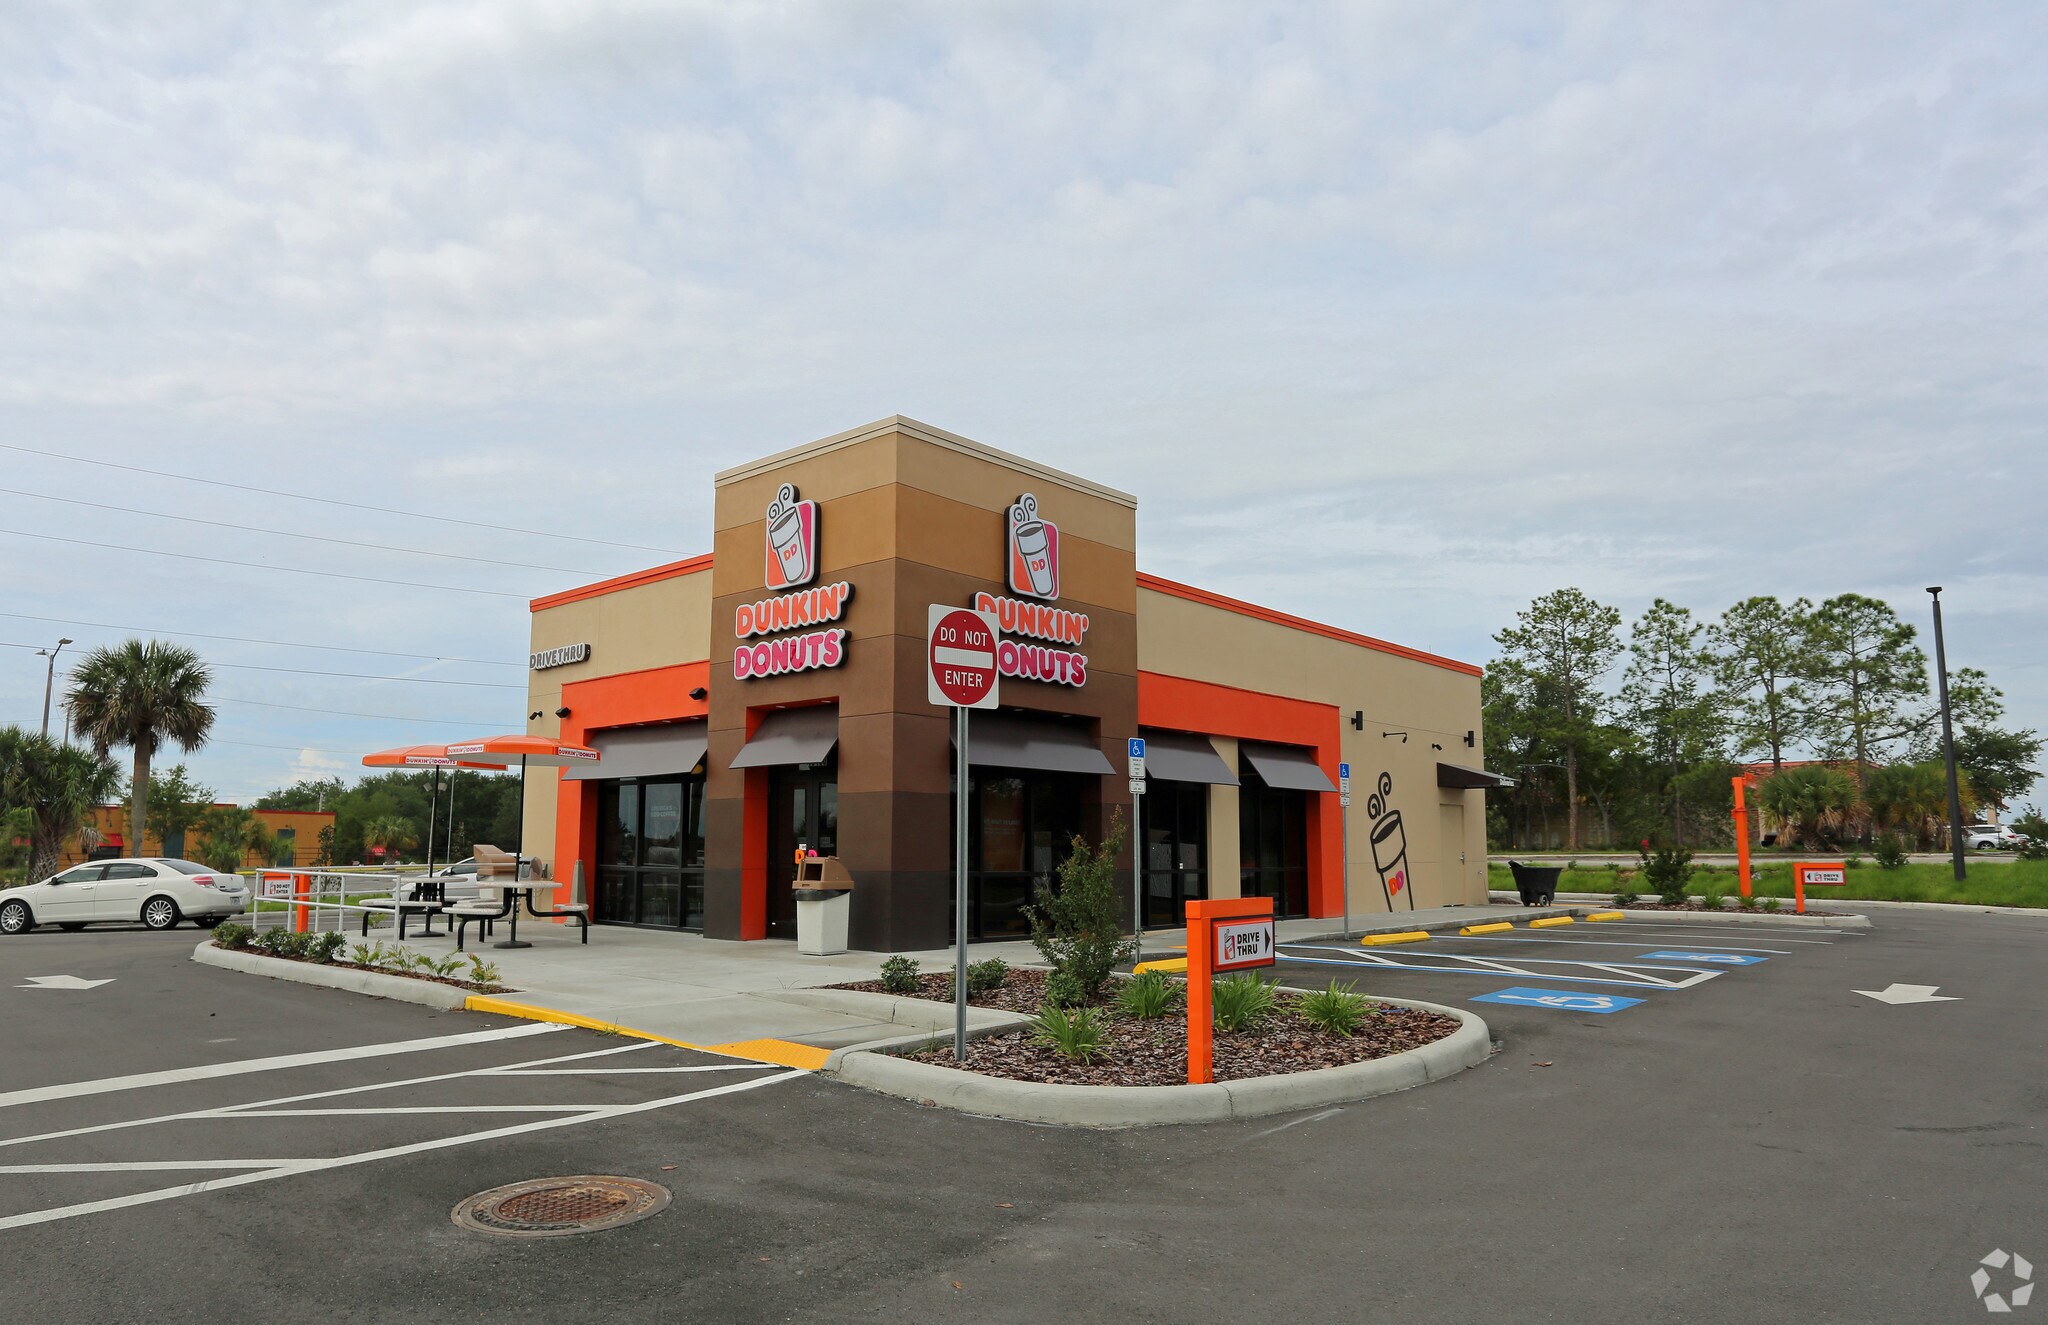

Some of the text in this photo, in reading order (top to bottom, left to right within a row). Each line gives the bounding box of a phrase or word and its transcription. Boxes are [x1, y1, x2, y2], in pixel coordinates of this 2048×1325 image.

[783, 543, 798, 561] DD
[1031, 558, 1046, 572] DD
[737, 584, 846, 636] DUNKIN'
[940, 626, 988, 647] DO NOT
[735, 631, 840, 678] DONUTS
[998, 640, 1087, 685] ONUTS
[945, 670, 983, 688] ENTER
[1237, 931, 1260, 945] DRIVE
[1237, 943, 1258, 957] THRU
